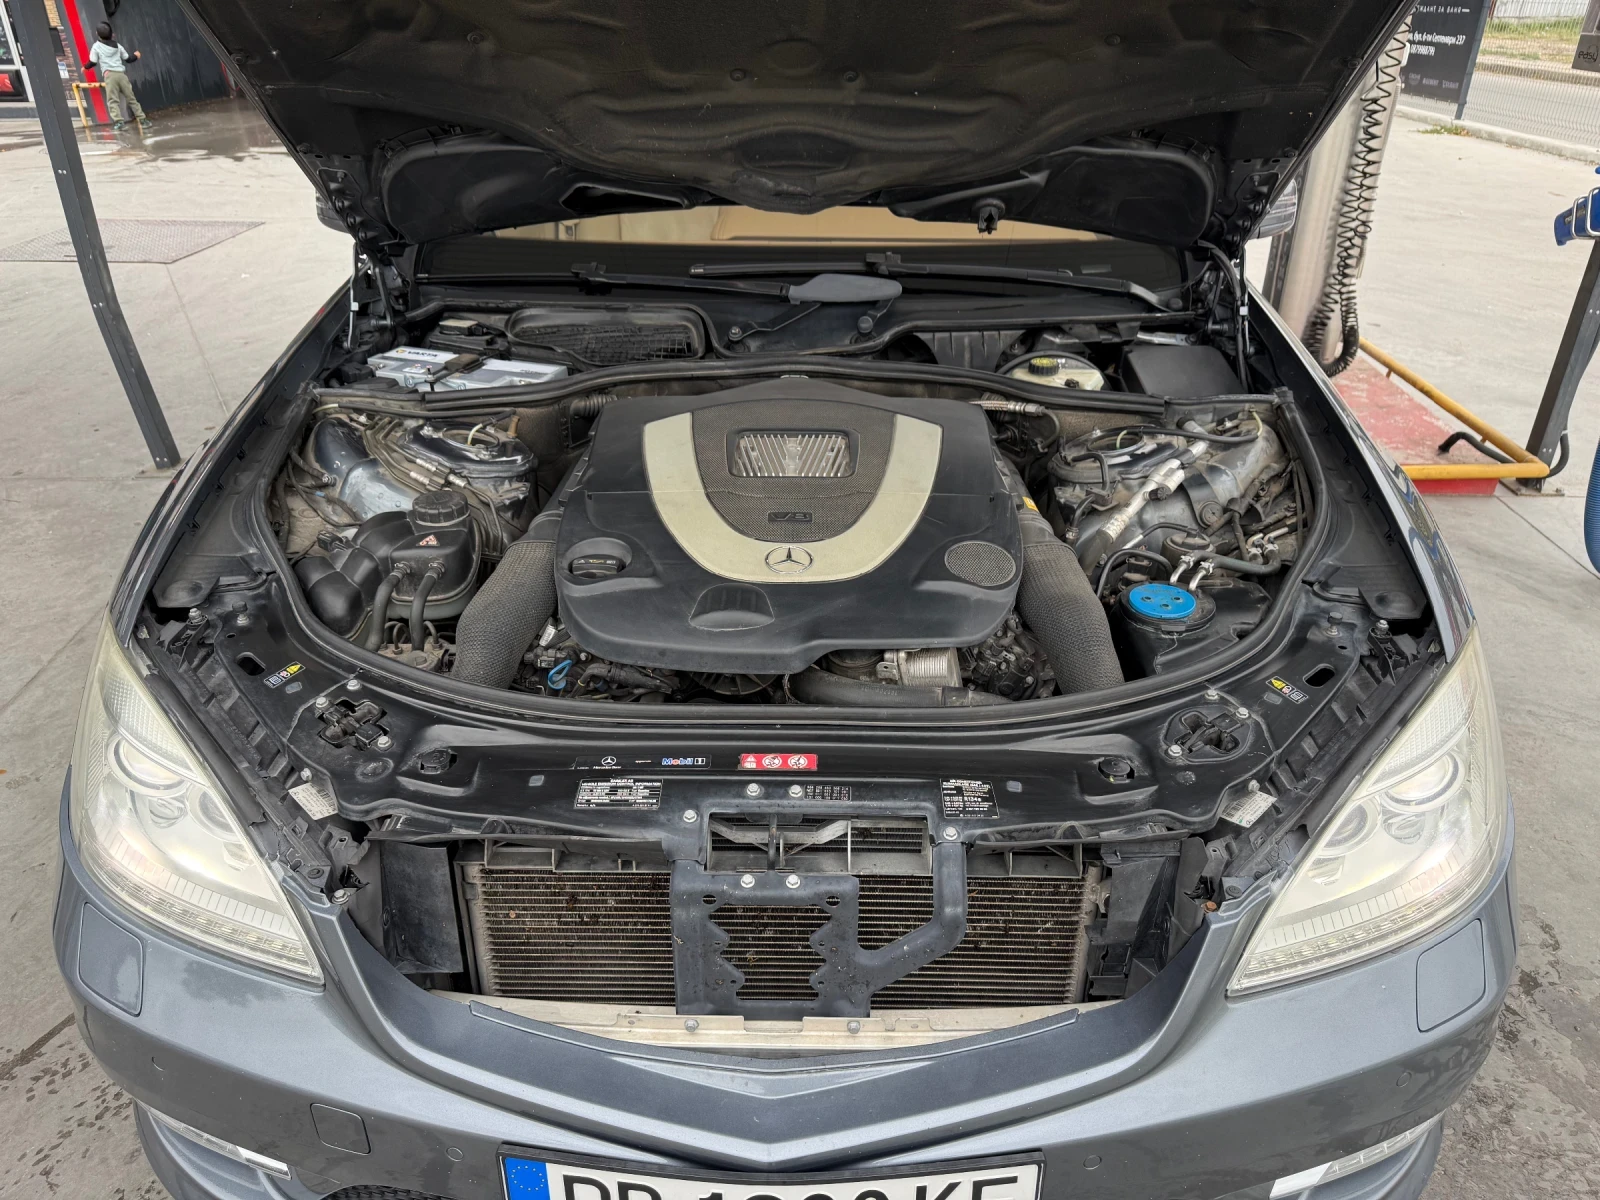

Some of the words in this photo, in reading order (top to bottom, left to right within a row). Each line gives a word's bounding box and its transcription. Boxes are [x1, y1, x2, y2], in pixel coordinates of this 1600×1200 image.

[1456, 34, 1466, 45] 237
[770, 512, 811, 522] V8
[662, 757, 693, 765] Mobil
